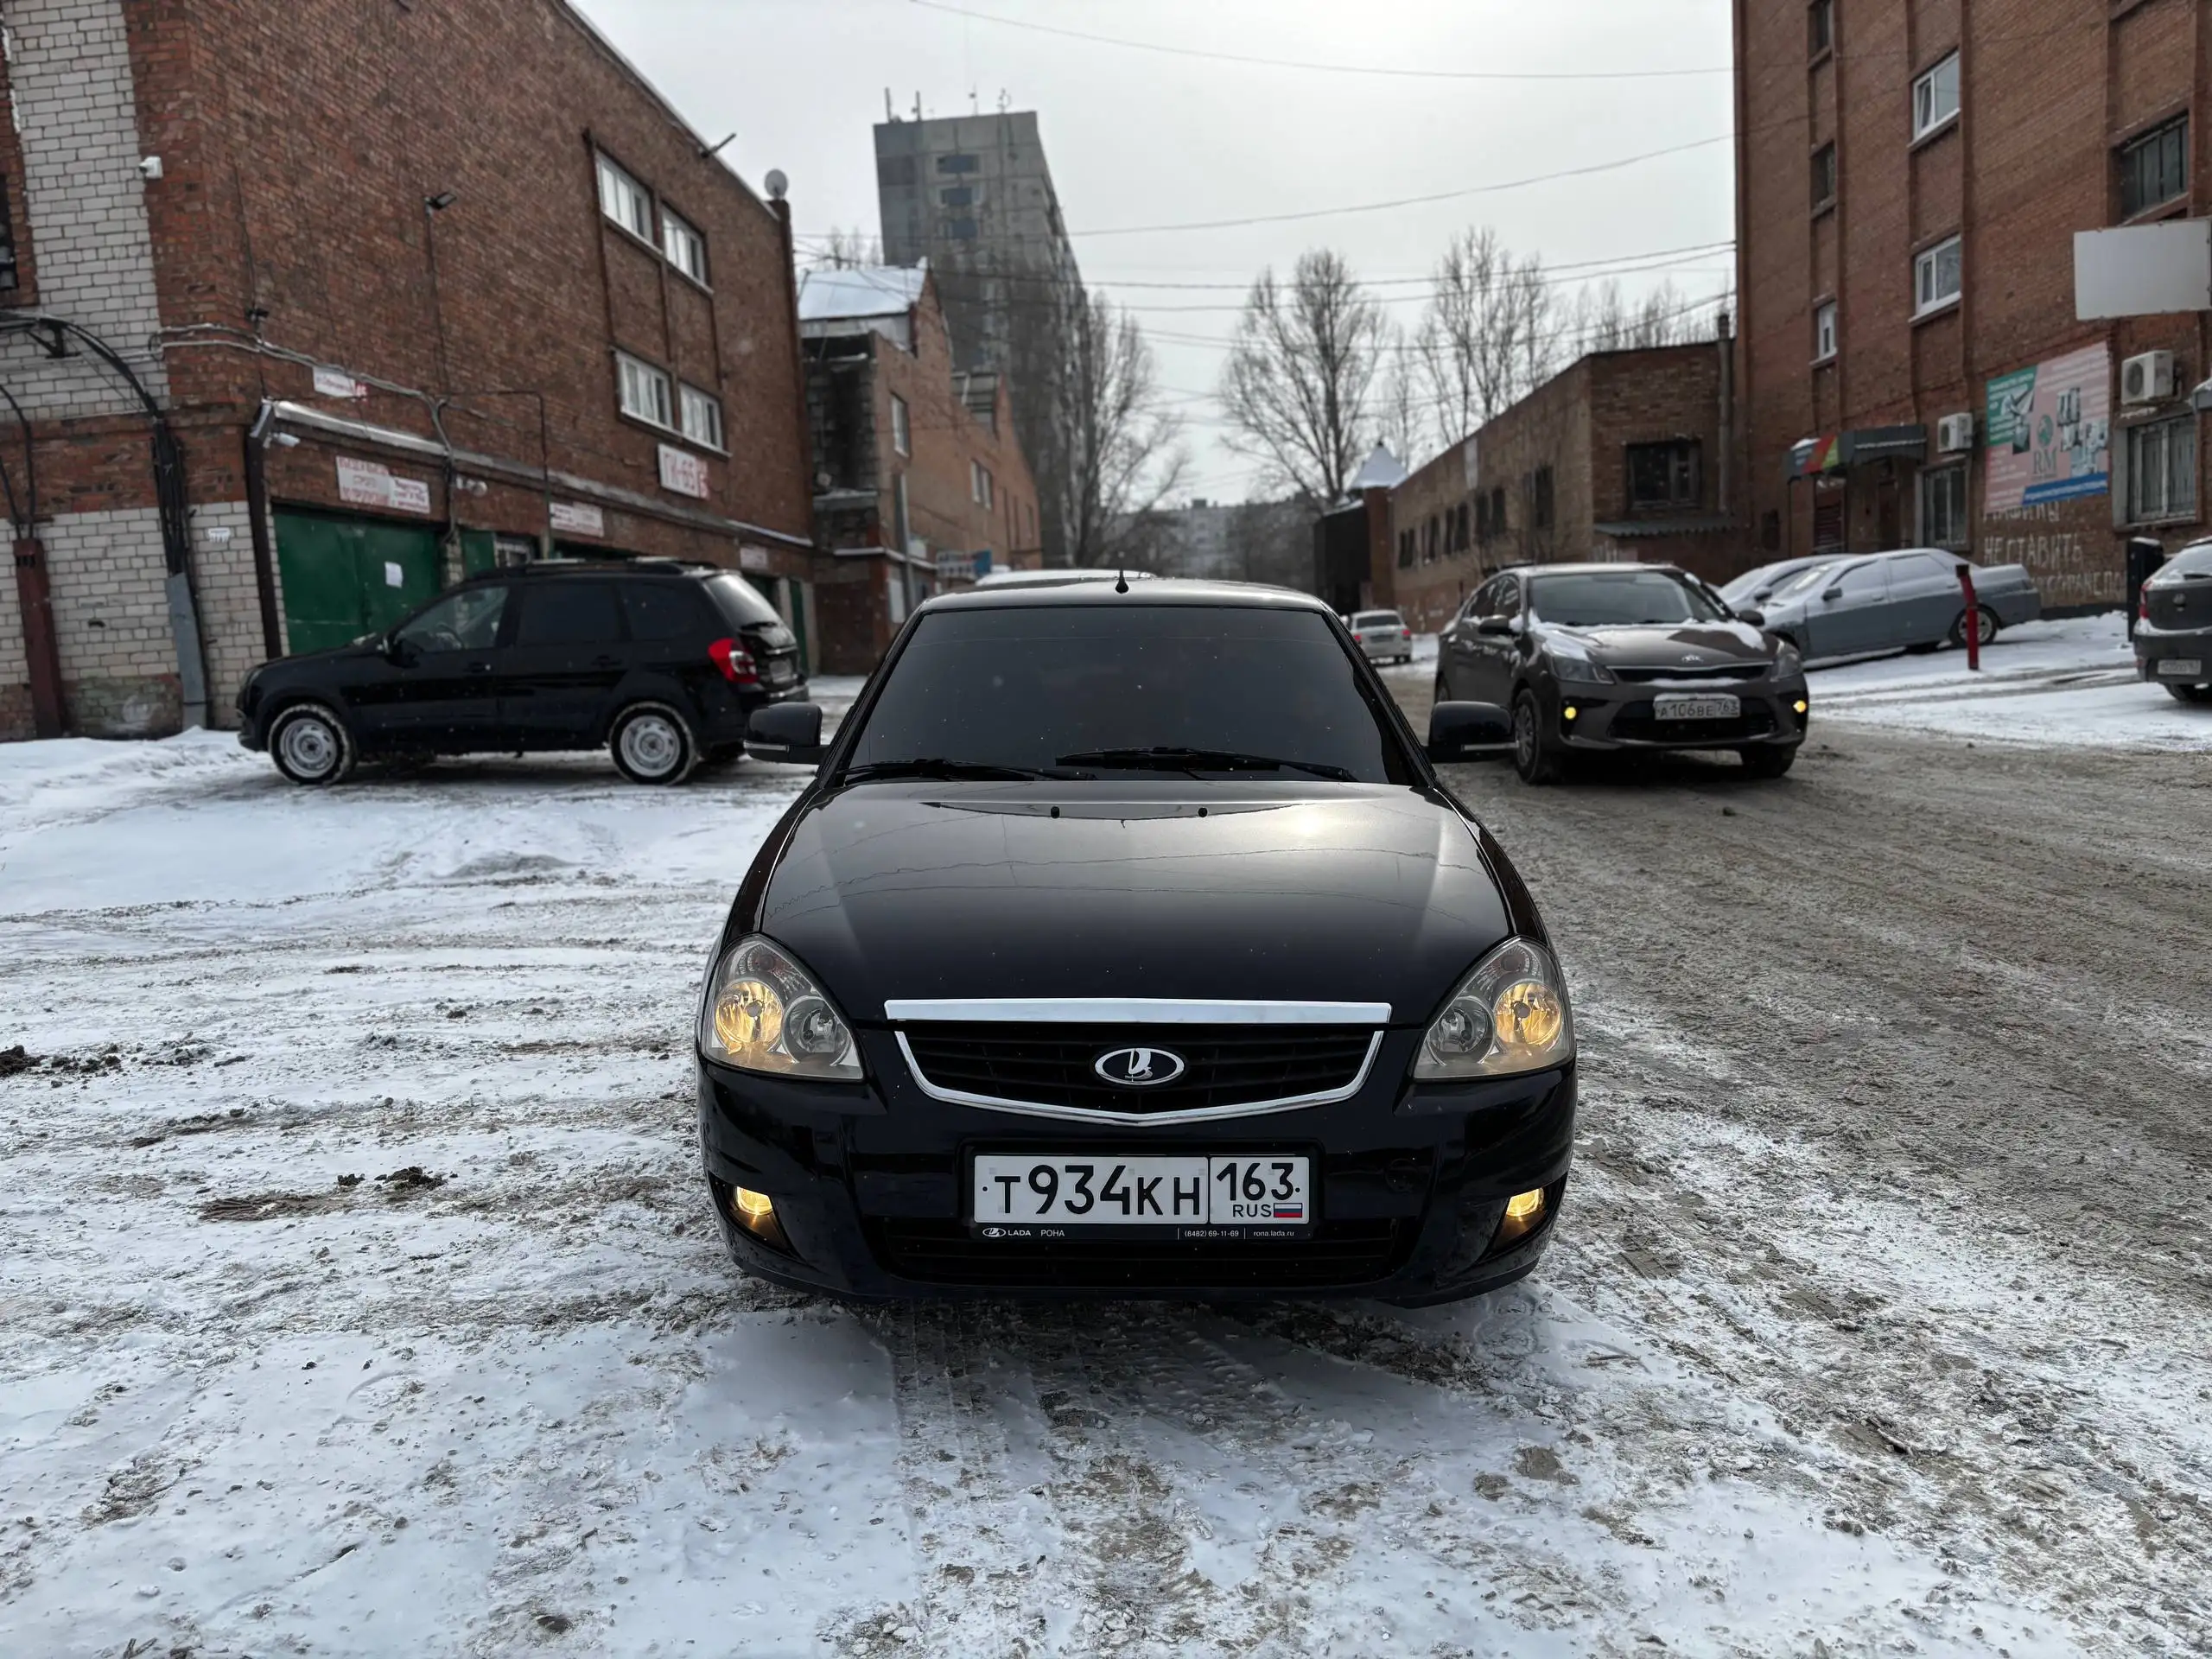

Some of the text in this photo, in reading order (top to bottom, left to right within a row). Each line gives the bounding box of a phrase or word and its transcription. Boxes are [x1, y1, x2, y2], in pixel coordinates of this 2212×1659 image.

[2032, 447, 2056, 475] RM
[994, 1162, 1294, 1216] Т934КН 163
[1232, 1204, 1272, 1217] RUS
[1040, 1229, 1065, 1237] РОНА
